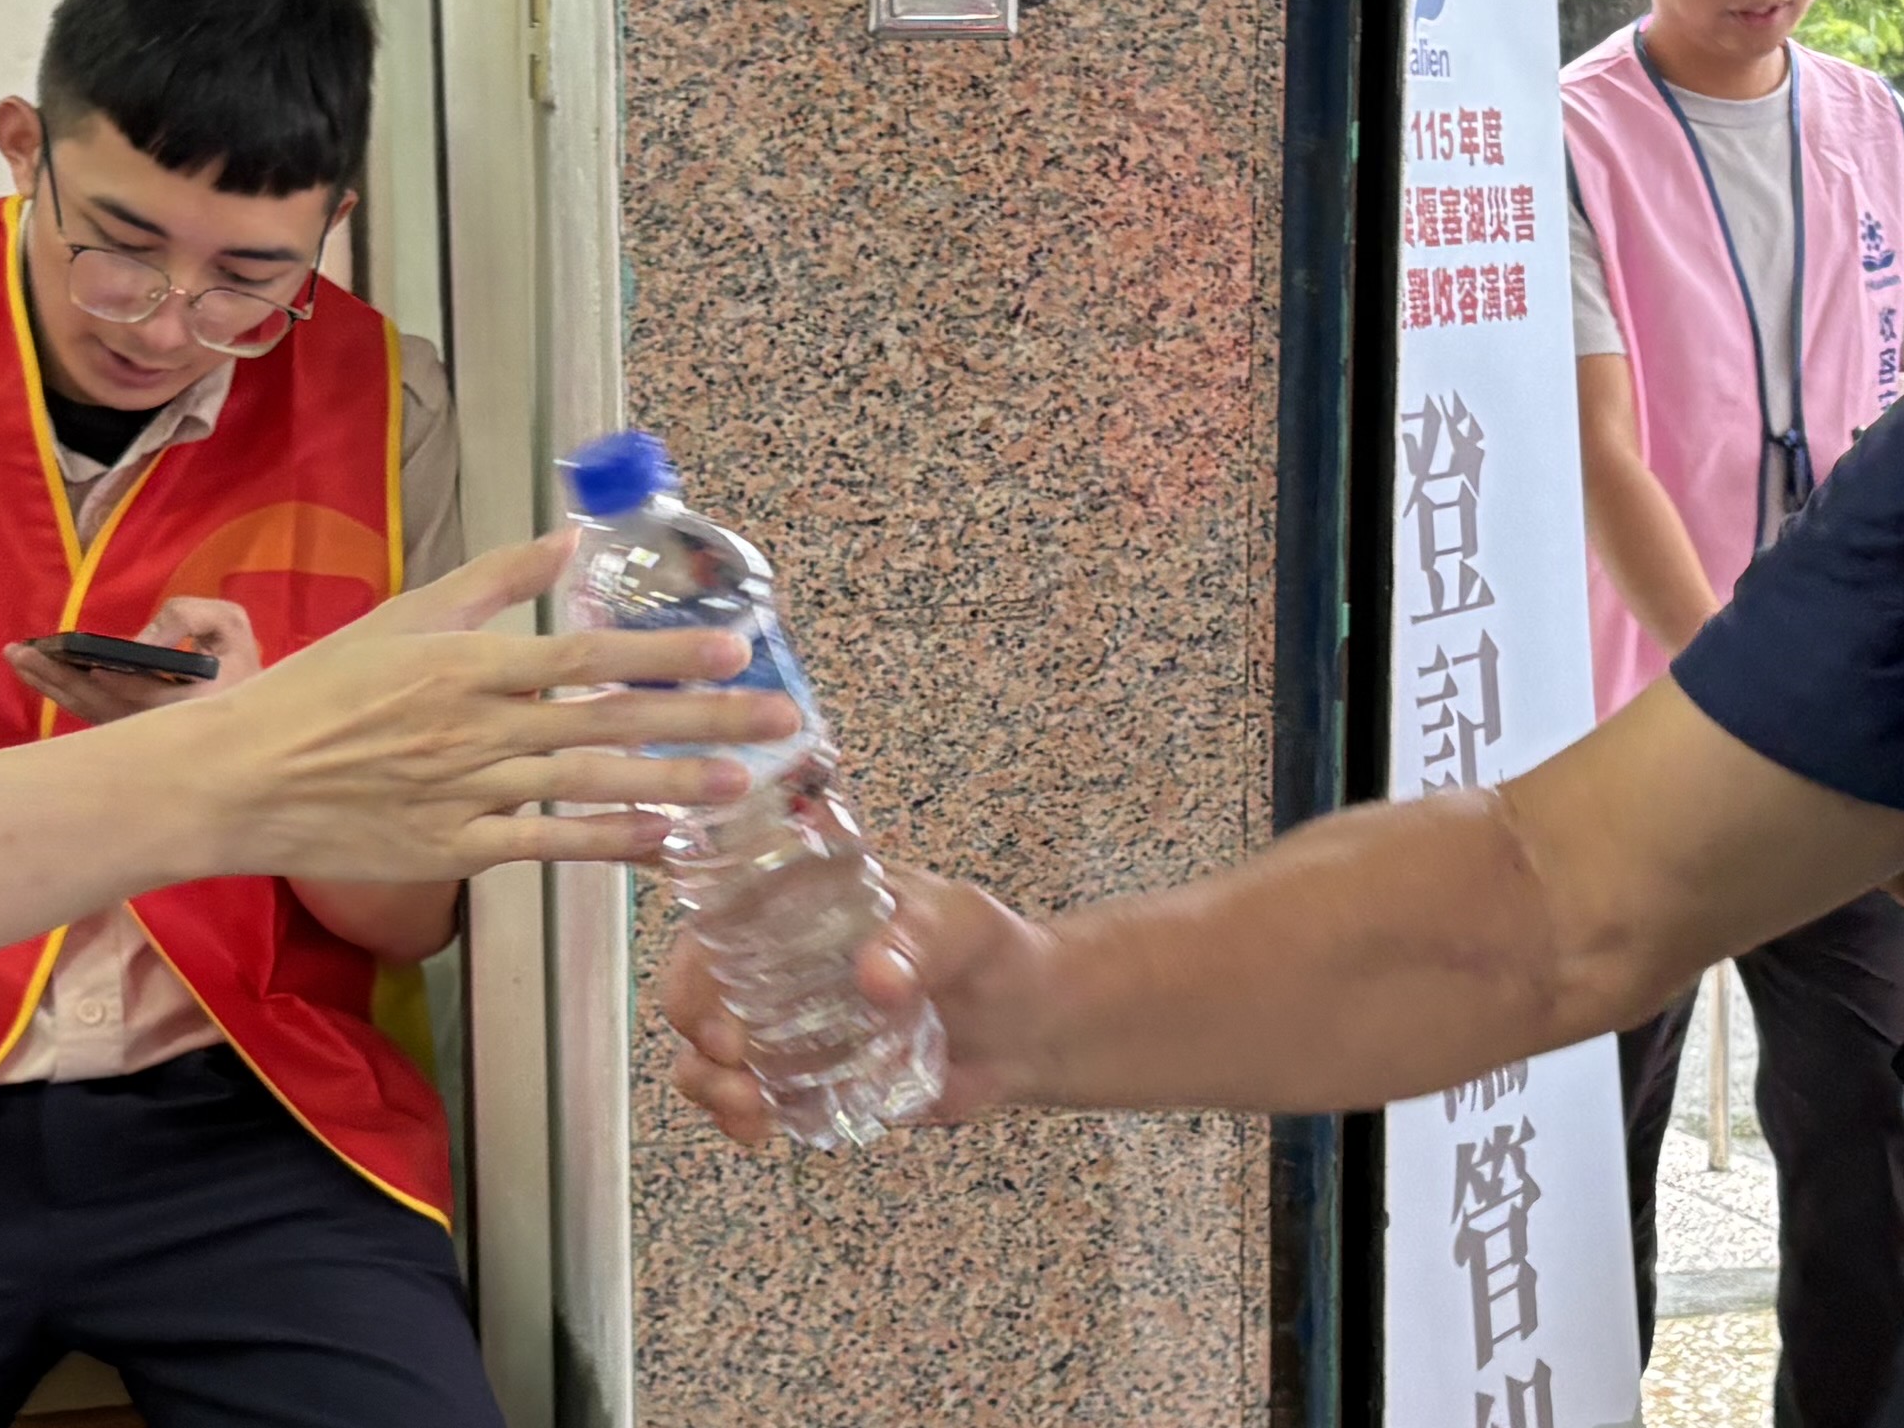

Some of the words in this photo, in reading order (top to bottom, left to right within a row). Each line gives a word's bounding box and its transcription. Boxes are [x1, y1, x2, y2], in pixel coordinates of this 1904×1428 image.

[1411, 105, 1505, 167] 115年度
[1402, 262, 1528, 330] 難收容演練
